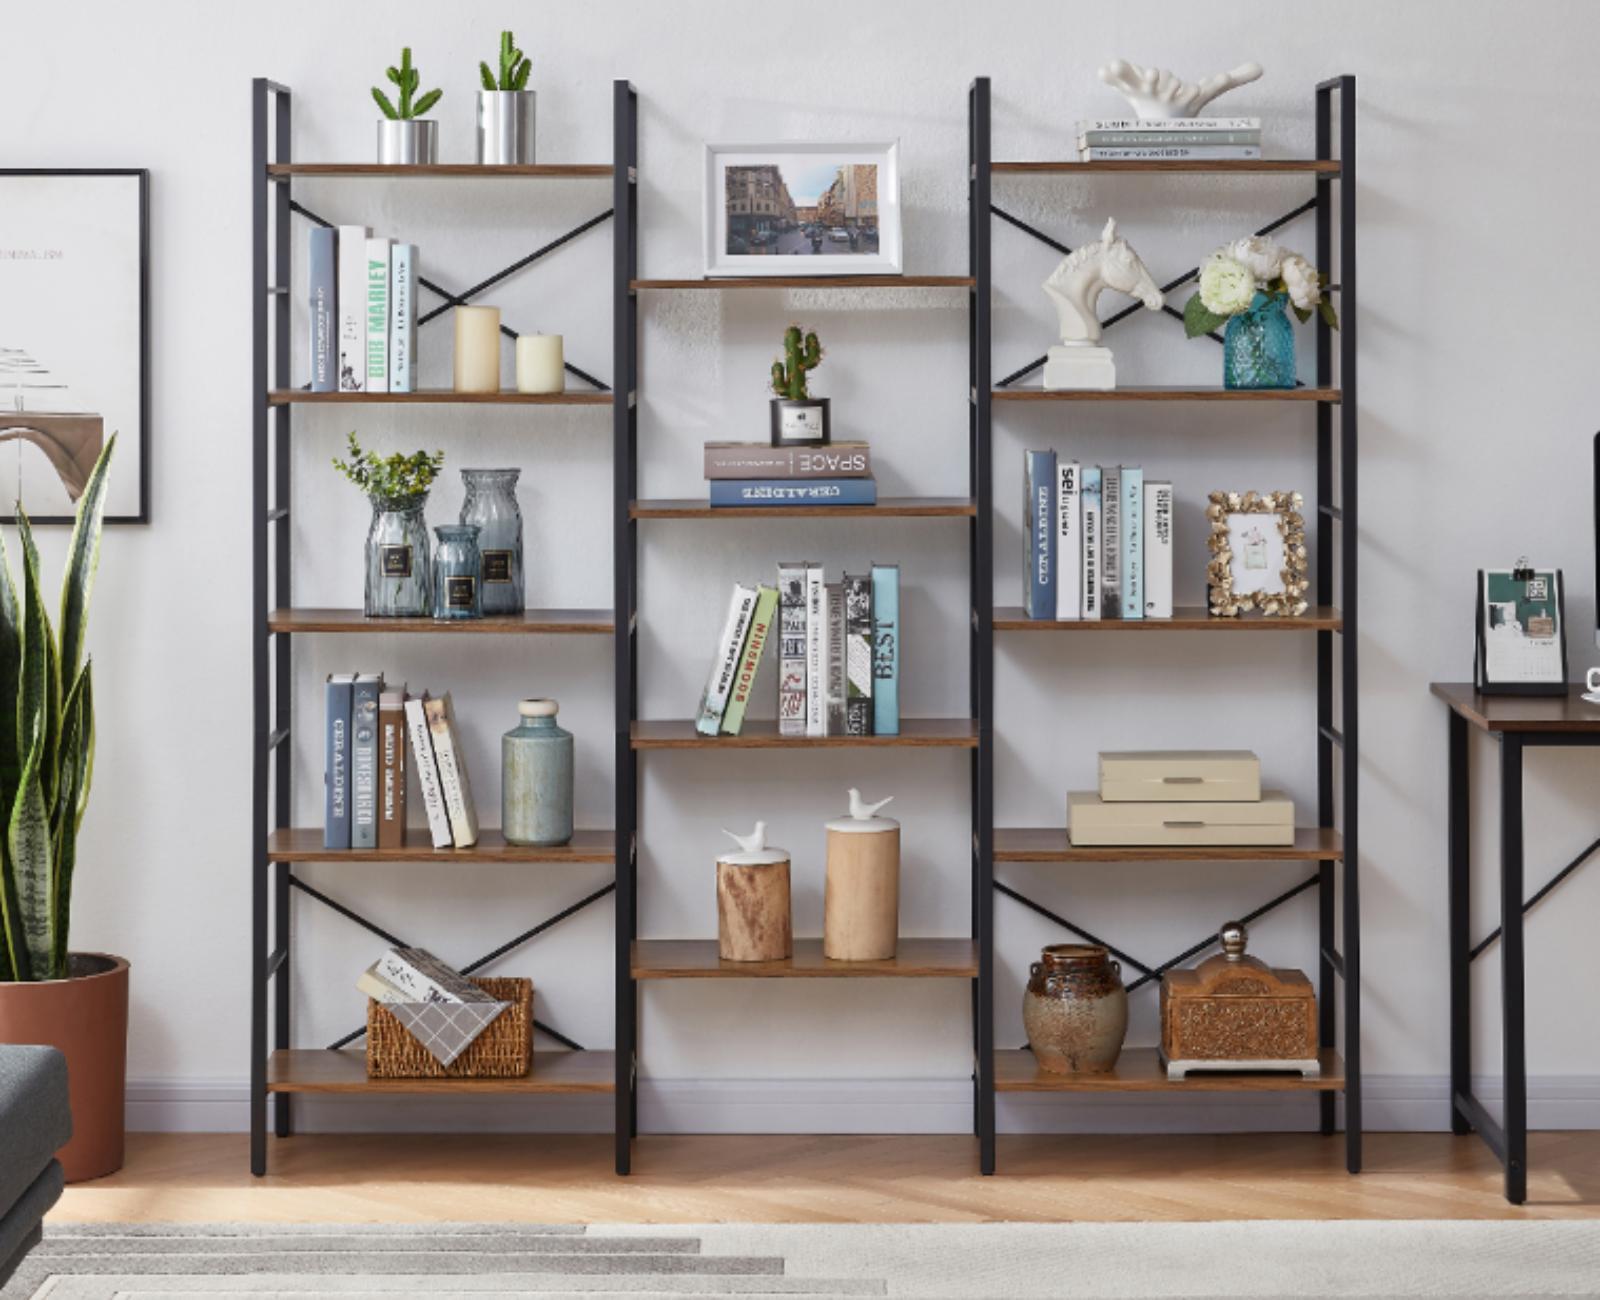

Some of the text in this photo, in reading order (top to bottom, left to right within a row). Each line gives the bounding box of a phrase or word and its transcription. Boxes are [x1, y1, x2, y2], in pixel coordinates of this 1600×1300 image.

[368, 260, 386, 333] MARLEY
[799, 454, 866, 472] SPACE
[874, 617, 895, 680] BEST
